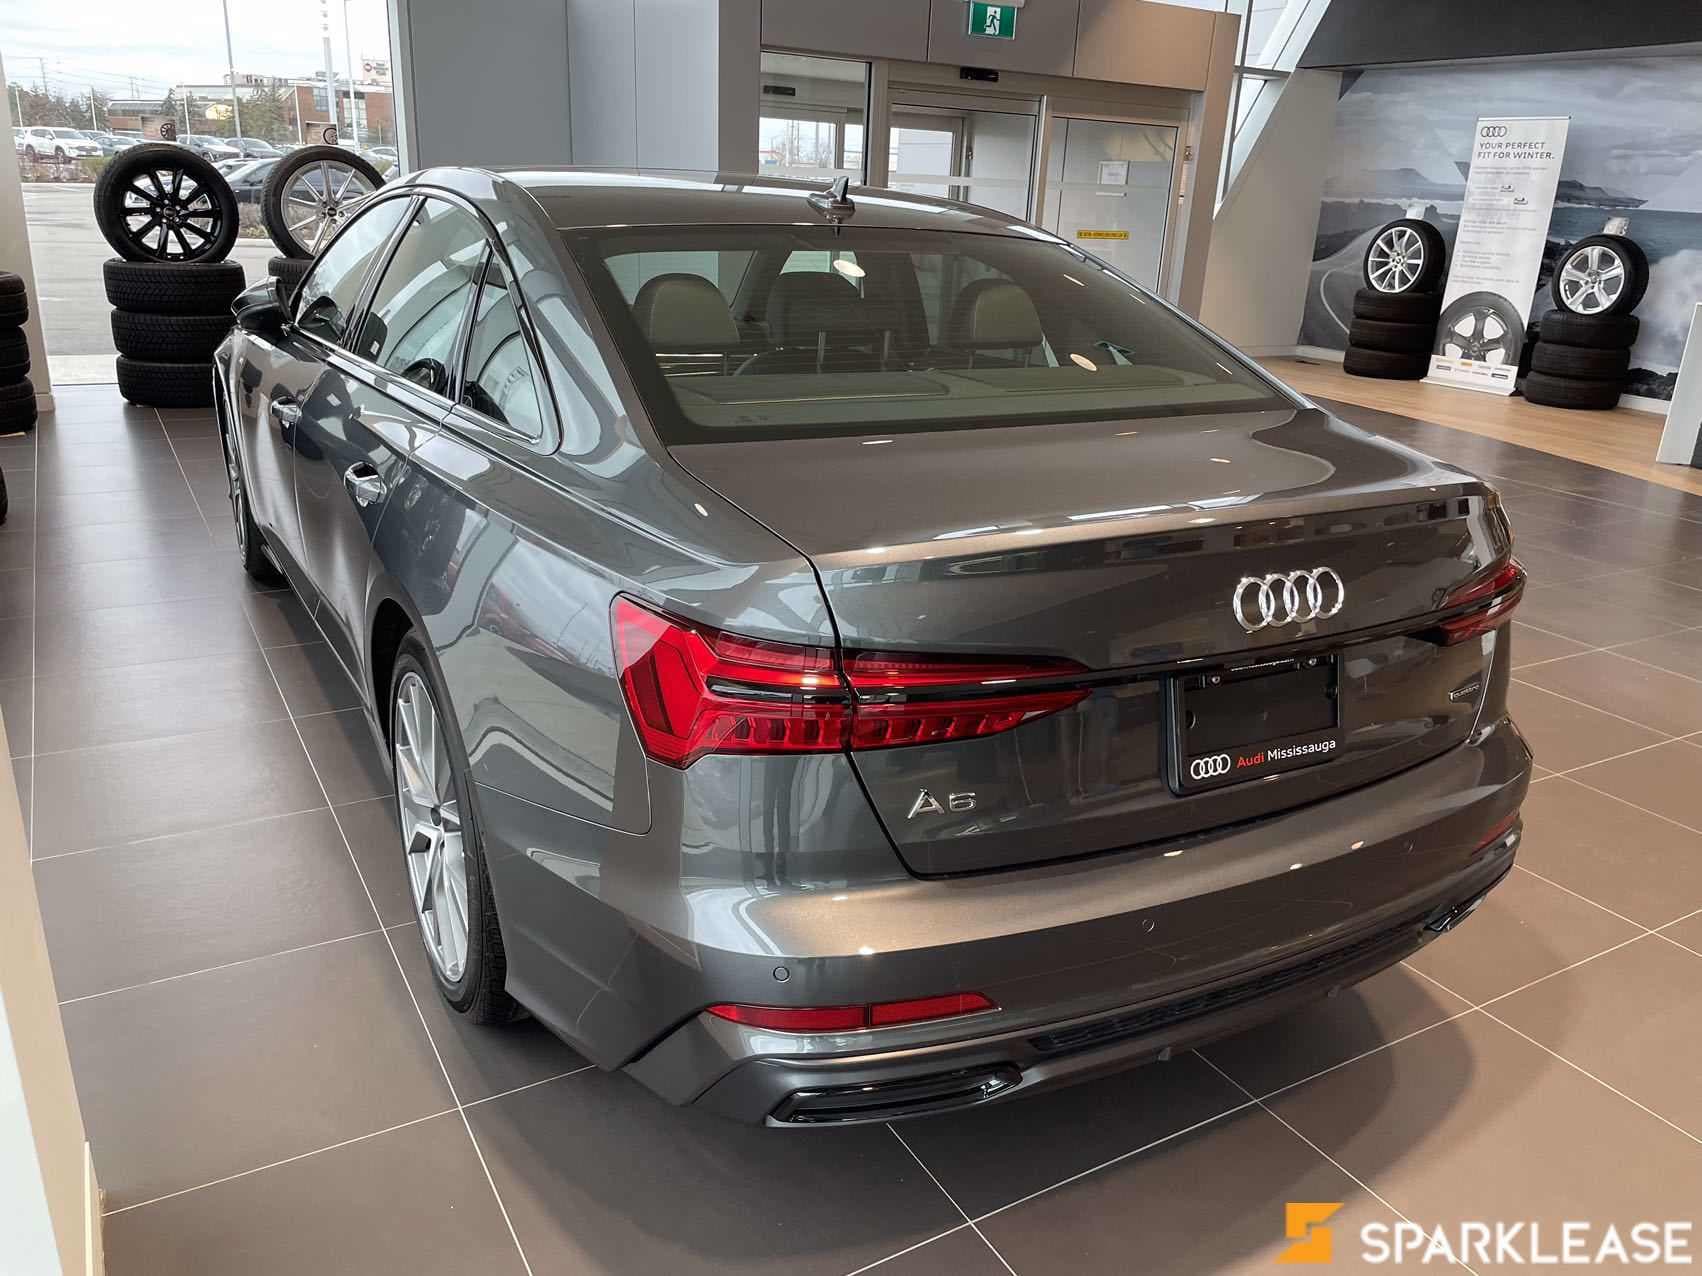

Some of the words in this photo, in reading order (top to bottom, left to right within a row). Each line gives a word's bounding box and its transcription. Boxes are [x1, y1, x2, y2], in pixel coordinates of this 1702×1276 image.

[1477, 151, 1492, 159] FIT
[1493, 151, 1511, 159] FOR
[1513, 151, 1555, 160] WINTER.
[1236, 752, 1265, 768] Audi
[1267, 739, 1336, 762] Mississauga
[906, 788, 977, 820] A6
